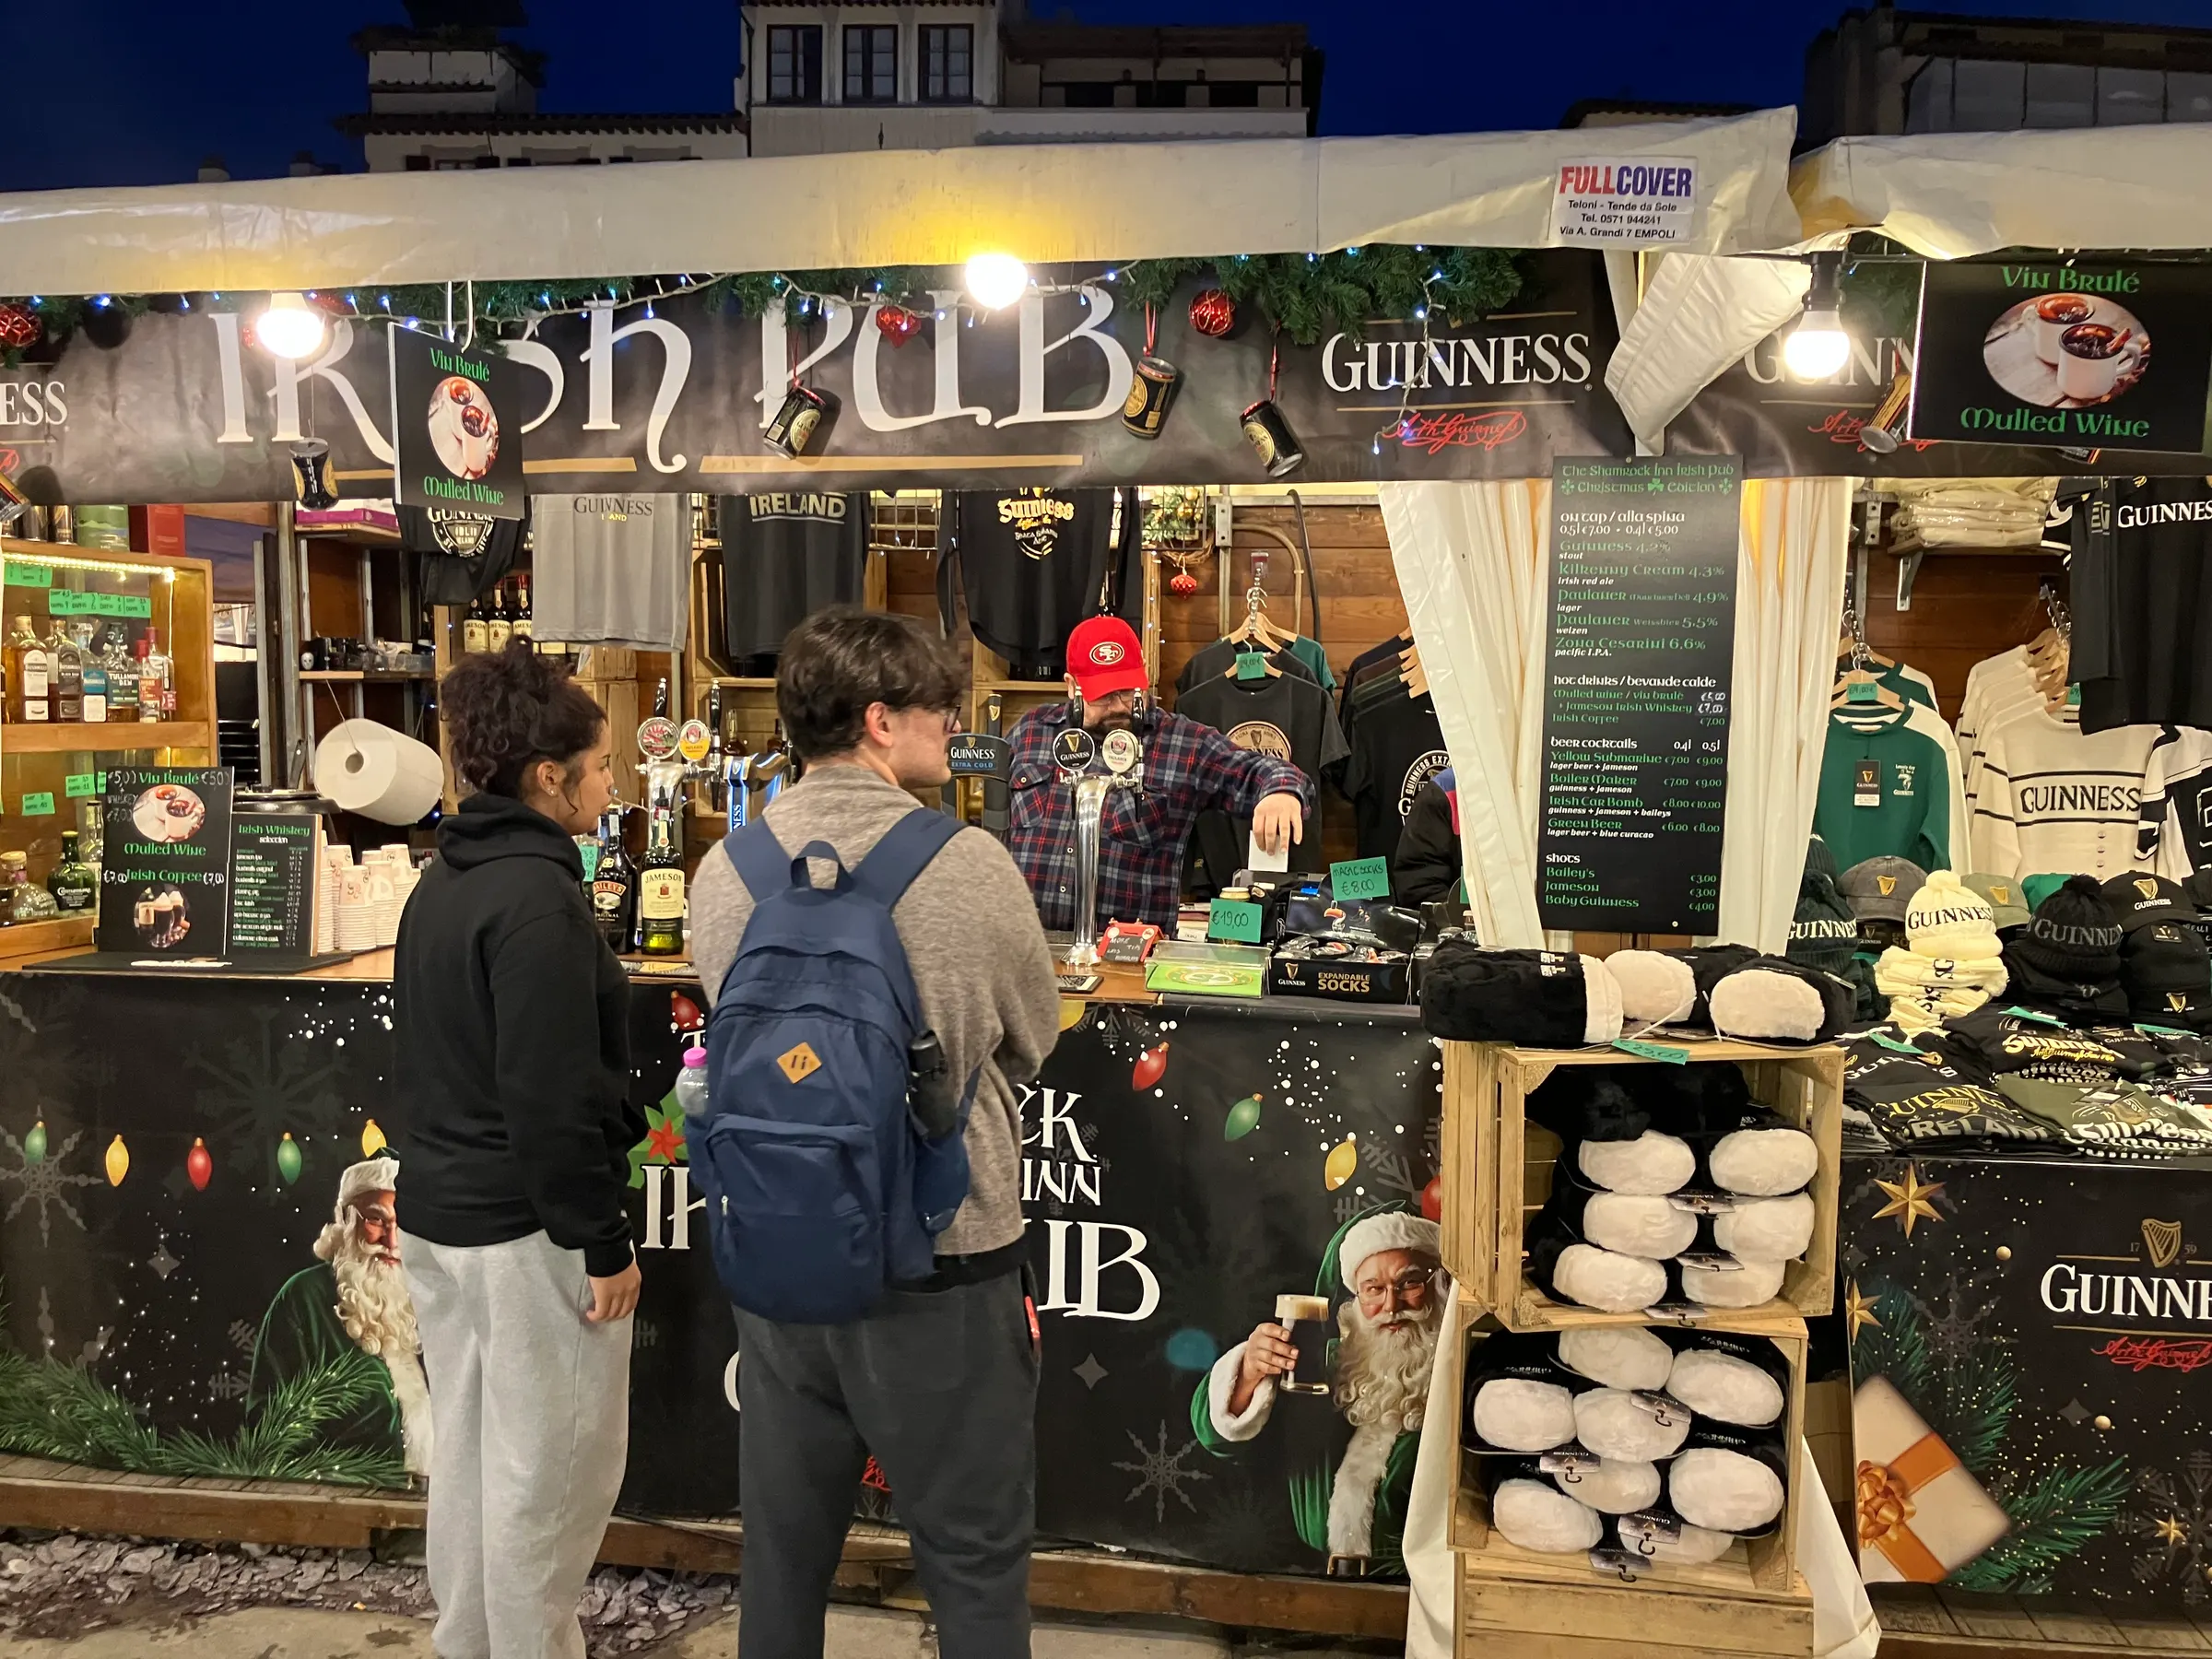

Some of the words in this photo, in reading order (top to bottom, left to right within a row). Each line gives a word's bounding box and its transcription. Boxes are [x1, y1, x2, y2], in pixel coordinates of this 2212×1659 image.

[1559, 166, 1691, 196] FULLCOVER
[1569, 200, 1596, 209] Teloni
[1608, 201, 1637, 211] Tende
[1640, 203, 1652, 211] da
[1654, 203, 1677, 212] Sole
[1582, 214, 1597, 223] Tel.
[1601, 215, 1623, 223] 0571
[1627, 216, 1661, 224] 944241
[1560, 227, 1574, 235] Via
[1577, 227, 1587, 236] A.
[1590, 228, 1623, 237] Grandi
[1635, 229, 1675, 239] EMPOLI
[2001, 266, 2050, 288] Vin
[2059, 267, 2139, 293] Brulé
[753, 284, 1135, 431] PUB
[1322, 332, 1591, 392] GUINNESS
[429, 347, 453, 371] Vin
[456, 355, 490, 382] Brulé
[1960, 407, 2066, 432] Mulled
[2076, 413, 2149, 437] Wine
[1562, 465, 1586, 476] The
[1590, 465, 1650, 477] Shamrock
[1654, 463, 1673, 477] Inn
[1677, 463, 1705, 476] Irish
[1708, 464, 1734, 478] Pub
[424, 477, 471, 502] Mulled
[473, 485, 503, 506] Wine
[1577, 481, 1644, 493] Christmas
[1667, 482, 1715, 492] Edition
[573, 496, 653, 516] GUINNESS
[749, 492, 846, 518] IRELAND
[1560, 512, 1579, 522] on
[1582, 512, 1606, 525] tap
[1618, 510, 1643, 523] alla
[1646, 511, 1685, 526] spina
[1560, 540, 1631, 551] Guinness
[1559, 562, 1629, 578] Kilkenny
[1633, 564, 1684, 575] Cream
[1688, 566, 1724, 578] 4.3%
[1583, 577, 1597, 585] red
[1599, 577, 1614, 585] ale
[1559, 589, 1626, 602] Paulaner
[1692, 592, 1729, 603] 4.9%
[1557, 604, 1582, 613] lager
[1558, 614, 1630, 627] Paulaner
[1682, 617, 1718, 629] 5.5%
[1556, 627, 1588, 635] weizen
[1555, 637, 1594, 648] Zona
[1598, 638, 1665, 649] Cesarini
[1669, 638, 1706, 650] 6.6%
[1555, 648, 1585, 657] pacific
[1587, 648, 1612, 656] I.P.A.
[1554, 676, 1576, 685] hot
[1578, 675, 1618, 686] drinks
[1628, 676, 1681, 687] bevande
[1682, 676, 1716, 688] calde
[1554, 688, 1594, 700] Mulled
[1596, 690, 1623, 700] wine
[1633, 691, 1650, 700] vin
[1566, 702, 1613, 712] Jameson
[1616, 702, 1641, 711] Irish
[1645, 702, 1692, 714] Whiskey
[1553, 713, 1578, 722] Irish
[1581, 713, 1618, 724] Coffee
[1551, 736, 1580, 747] beer
[1582, 737, 1638, 749] cocktails
[951, 746, 994, 759] GUINNESS
[1060, 752, 1090, 761] GUINNESS
[1551, 751, 1591, 761] Yellow
[1594, 752, 1662, 763] Submarine
[1550, 761, 1573, 771] lager
[139, 772, 159, 783] Vin
[164, 772, 199, 784] Brulé
[1406, 758, 1430, 794] GUINNESS
[1550, 773, 1589, 784] Boiler
[1591, 774, 1637, 785] Maker
[1549, 795, 1579, 806] Irish
[1582, 796, 1605, 806] Car
[1607, 797, 1643, 807] Bomb
[2019, 785, 2142, 814] GUINNESS
[1548, 818, 1588, 828] Green
[1591, 818, 1622, 830] Beer
[239, 824, 263, 834] Irish
[265, 825, 311, 837] Whiskey
[1547, 829, 1571, 838] lager
[1571, 829, 1591, 837] beer
[1599, 830, 1618, 838] blue
[124, 842, 170, 854] Mulled
[174, 844, 206, 856] Wine
[1546, 853, 1581, 864] shots
[127, 868, 156, 881] Irish
[159, 869, 202, 883] Coffee
[645, 873, 683, 884] JAMESON
[1547, 867, 1595, 879] Bailey's
[1341, 879, 1375, 896] €8,00
[1545, 881, 1599, 892] Jameson
[1546, 895, 1578, 907] Baby
[1580, 896, 1639, 907] Guinness
[2135, 899, 2171, 911] GUINNESS
[1908, 906, 1994, 930] GUINNES
[1278, 978, 1306, 986] GUINNESS
[1318, 971, 1371, 982] EXPANDABLE
[1318, 979, 1371, 993] SOCKS
[1021, 1159, 1101, 1206] INN
[2041, 1264, 2212, 1320] GUINNE
